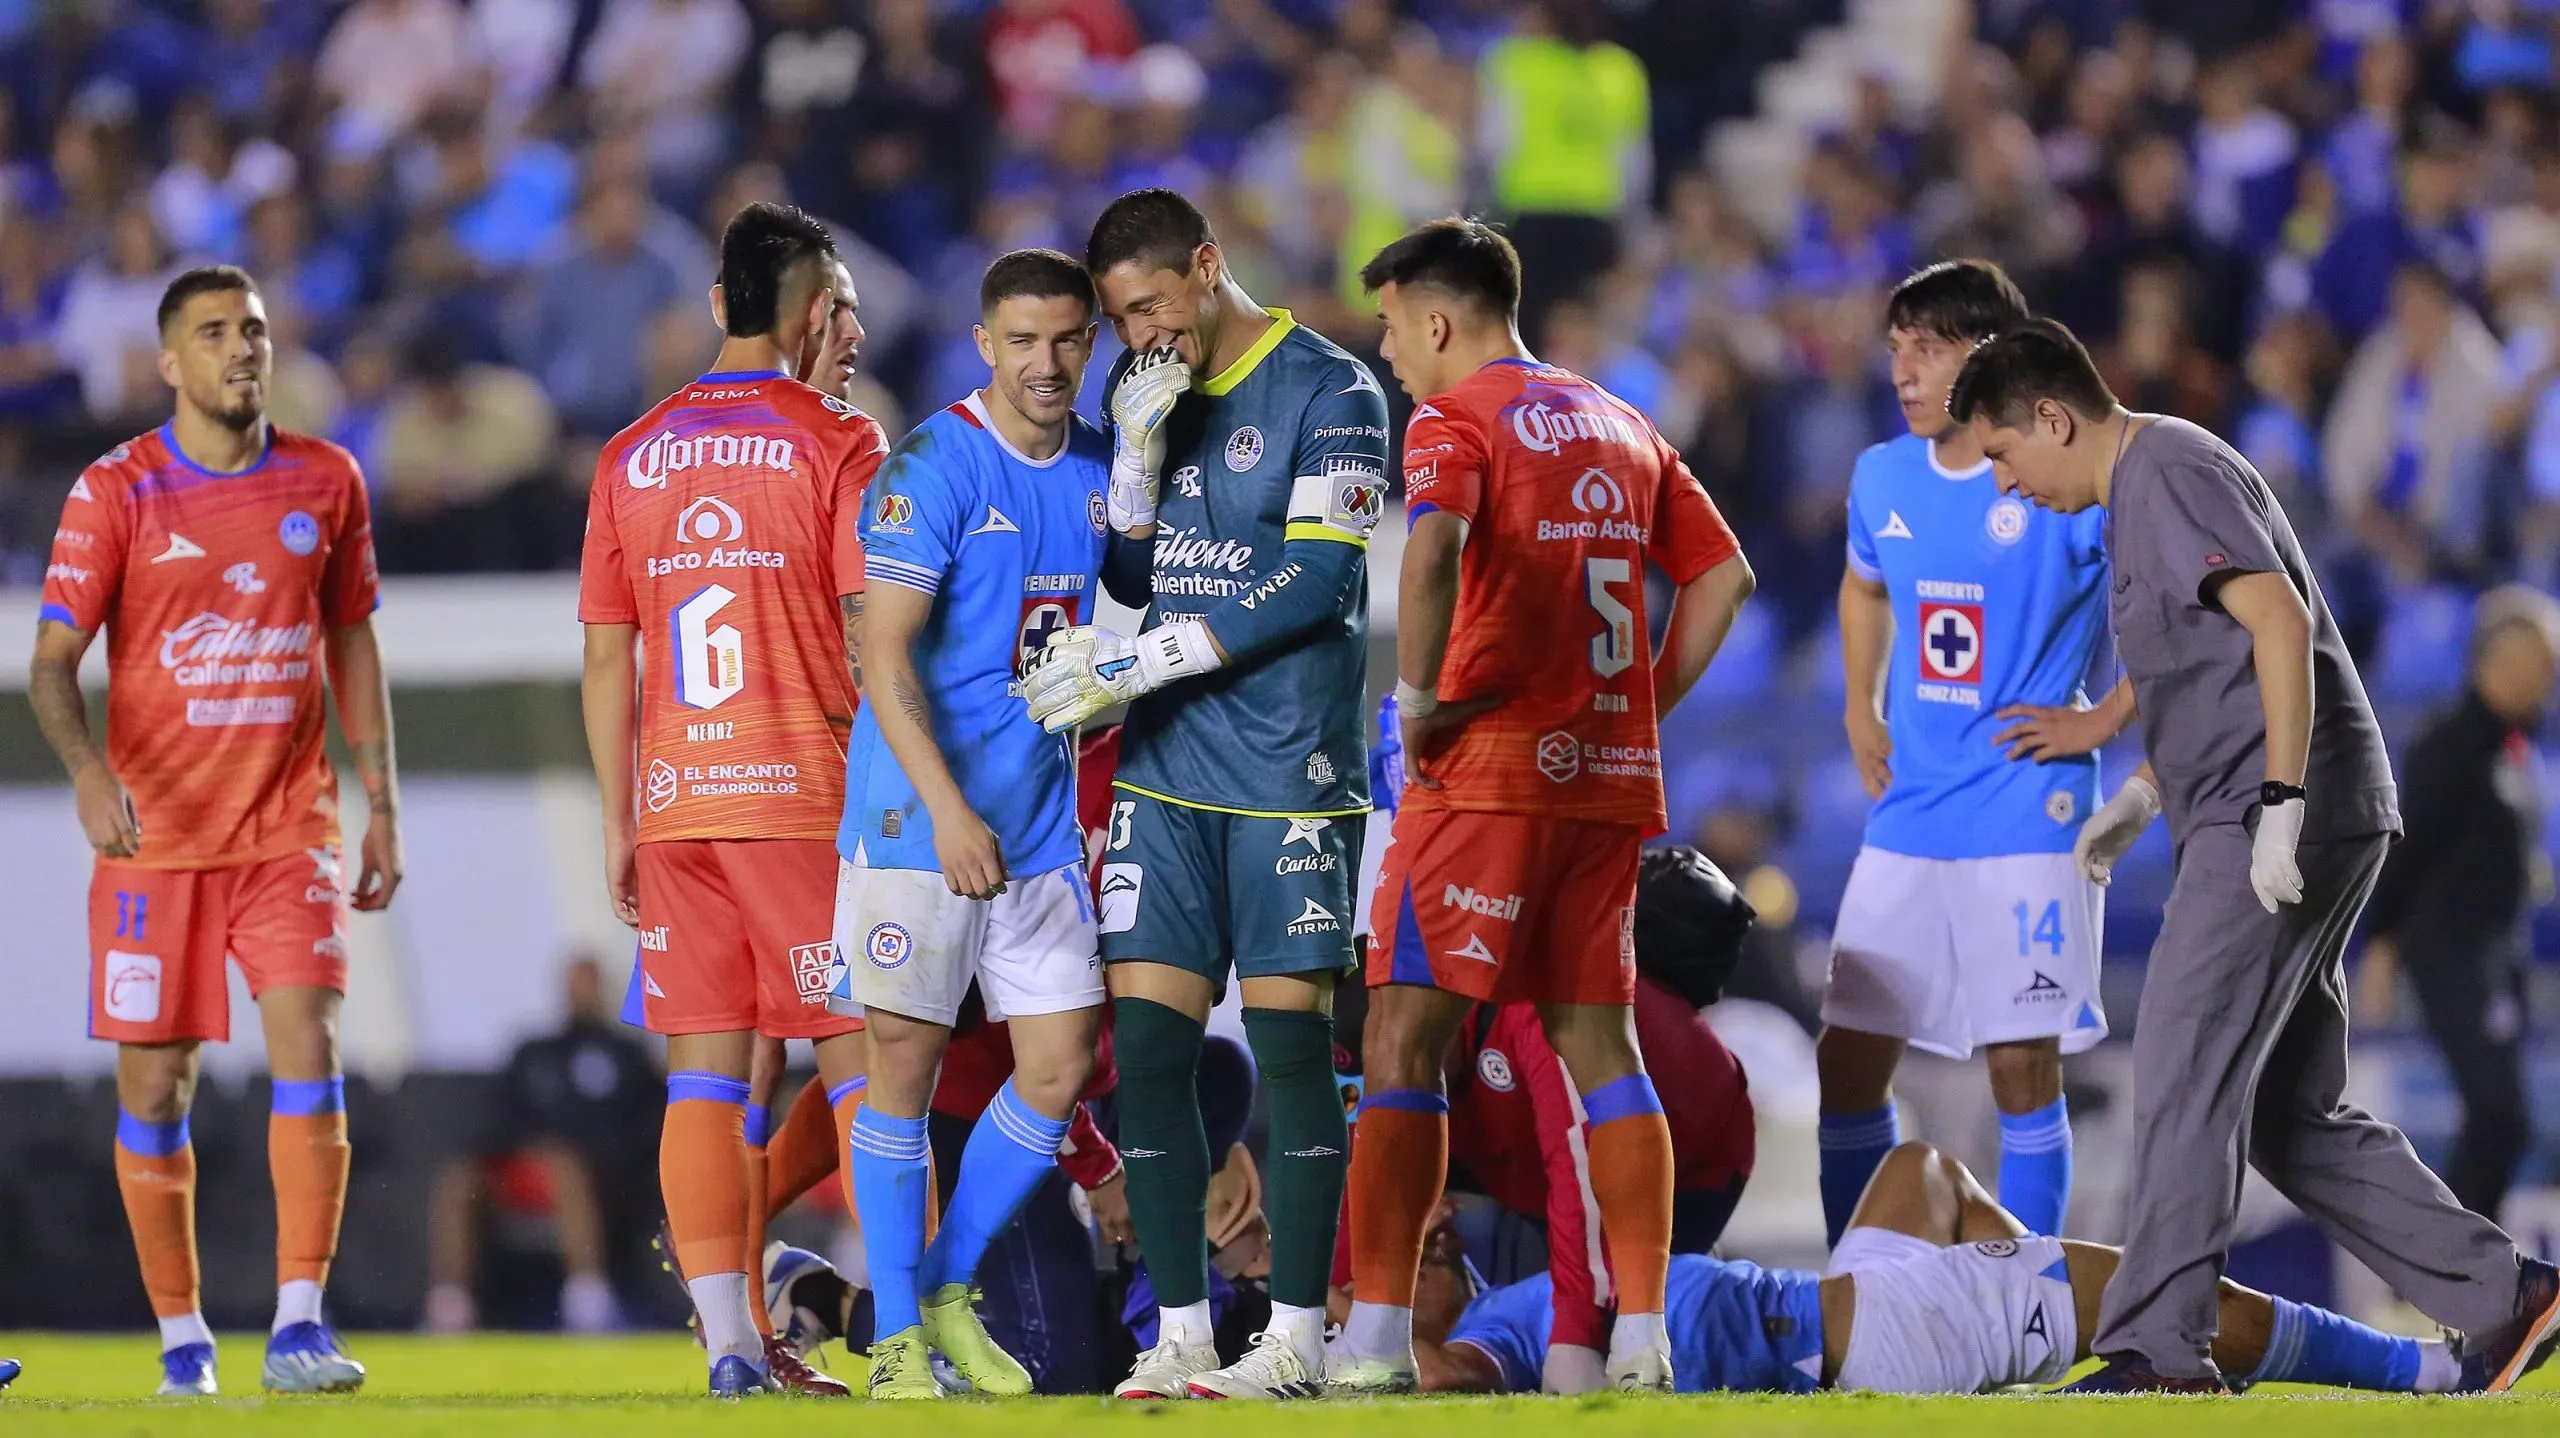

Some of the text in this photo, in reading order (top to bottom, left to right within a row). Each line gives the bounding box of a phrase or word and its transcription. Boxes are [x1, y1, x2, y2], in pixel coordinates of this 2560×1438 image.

[688, 388, 761, 401] PIRMA
[1314, 425, 1384, 440] Primera Plus
[626, 430, 795, 490] Corona
[1327, 458, 1382, 477] Hilton
[1537, 518, 1649, 546] Banco Azteca
[1153, 519, 1254, 573] aliente
[705, 547, 786, 568] Azteca
[1024, 573, 1086, 593] CEMENTO
[1916, 579, 1985, 602] CEMENTO
[1586, 557, 1634, 680] 5
[670, 583, 745, 711] 6
[723, 648, 737, 687] Orgullo
[687, 722, 734, 743] MERAZ
[1584, 744, 1598, 758] EL
[684, 764, 798, 780] EL ENCANTO
[1307, 762, 1333, 781] ALTAS
[691, 782, 798, 796] DESARROLLOS
[1275, 853, 1319, 875] Carl's
[1443, 884, 1521, 921] Nazil
[1287, 920, 1341, 937] PIRMA
[2012, 899, 2065, 957] 14
[640, 927, 668, 951] azil
